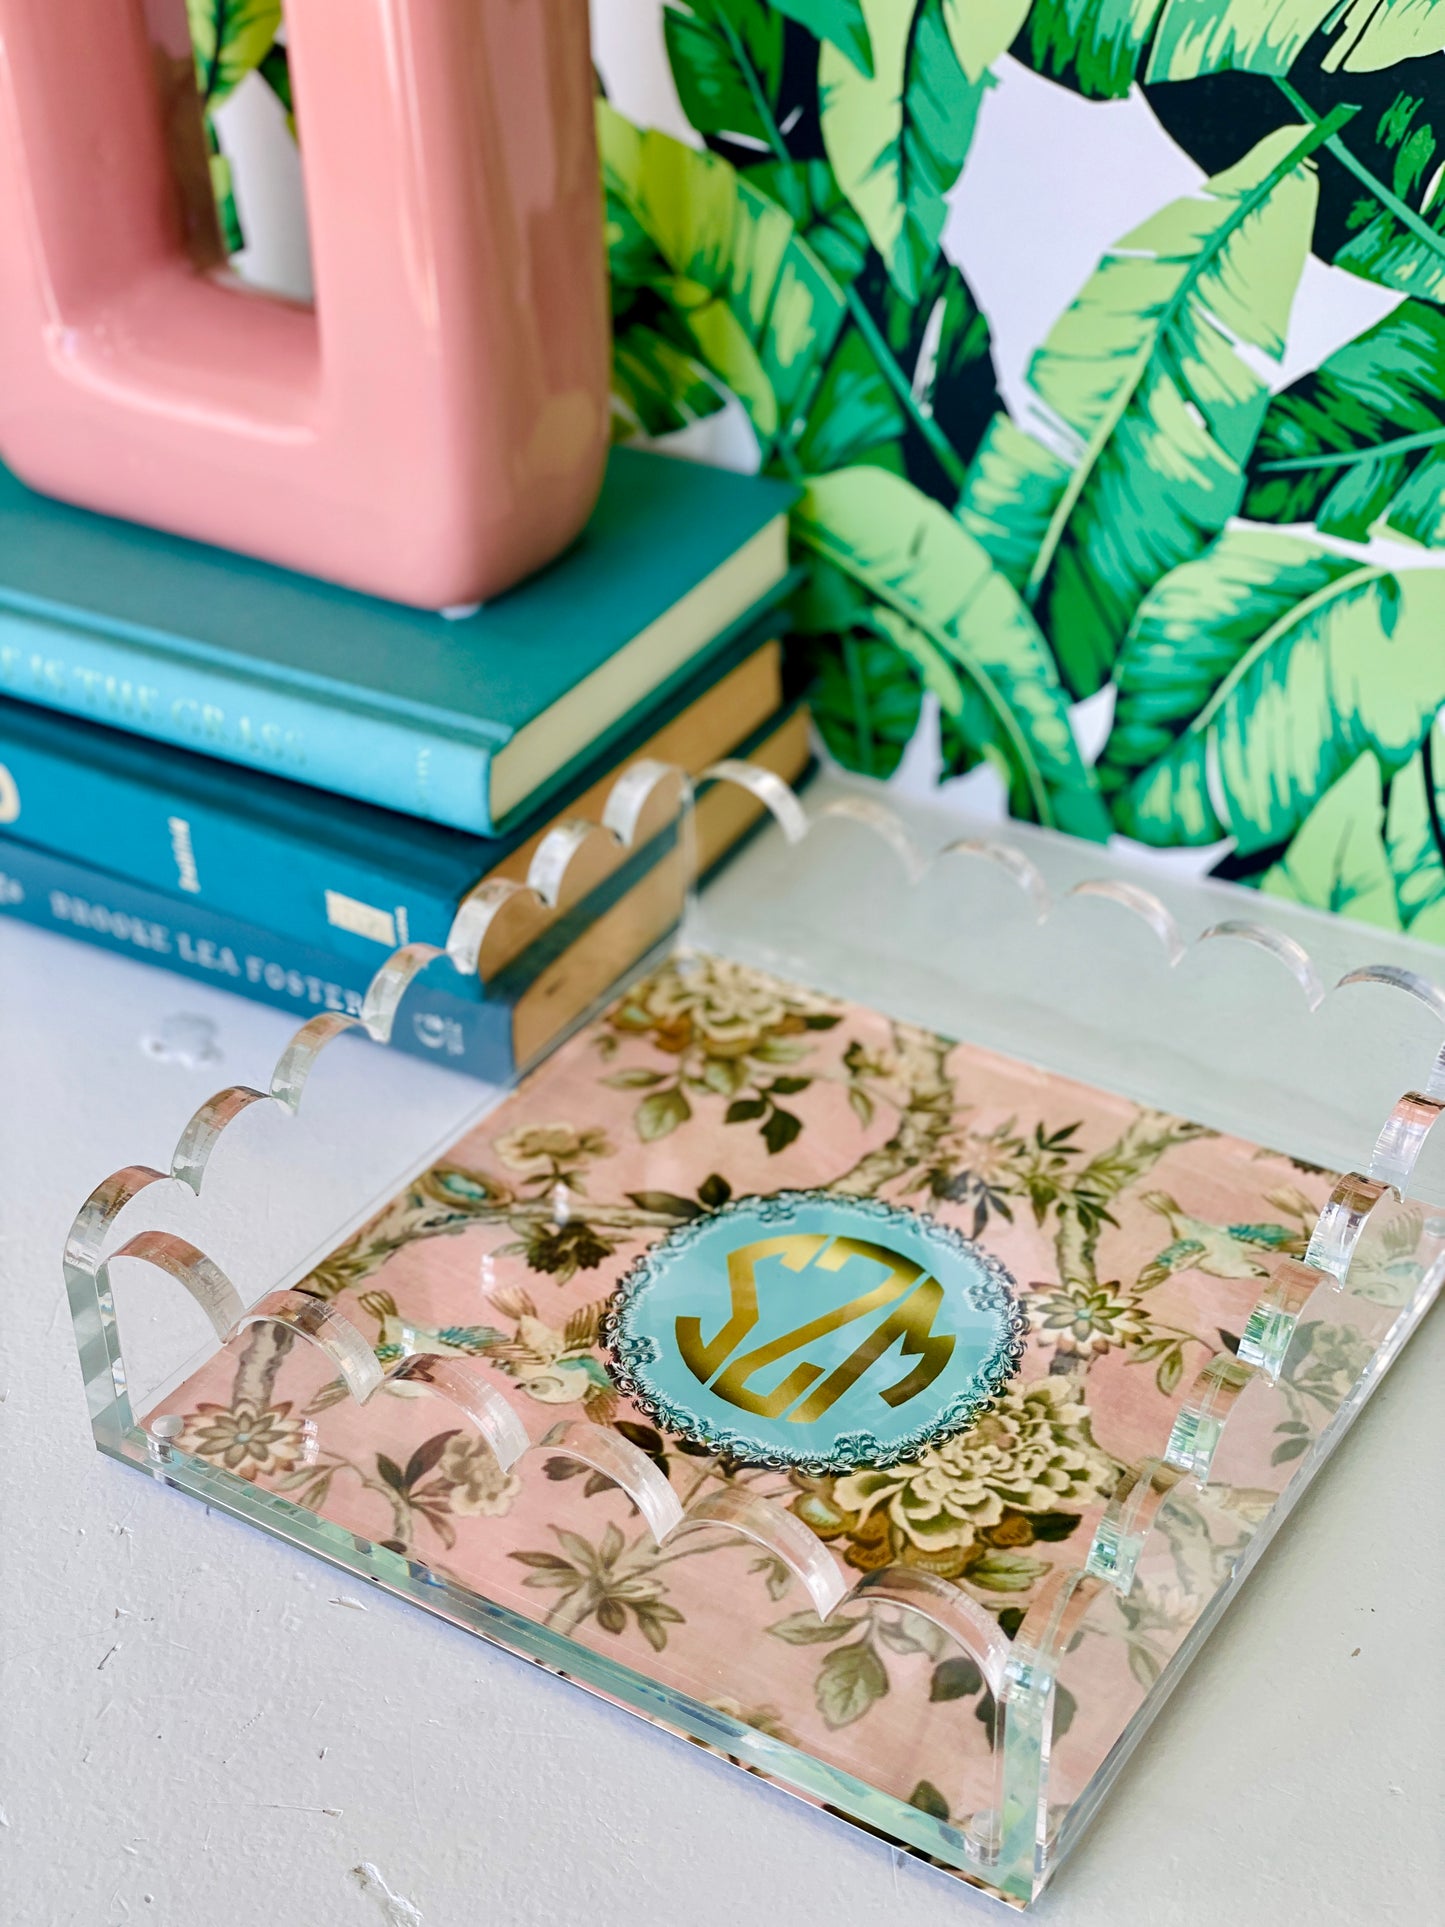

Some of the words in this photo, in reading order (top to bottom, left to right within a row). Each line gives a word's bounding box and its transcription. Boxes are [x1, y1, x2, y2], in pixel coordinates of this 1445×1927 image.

[51, 889, 172, 954] BROOKE
[176, 932, 241, 977] LEA
[245, 955, 365, 1017] FOSTER
